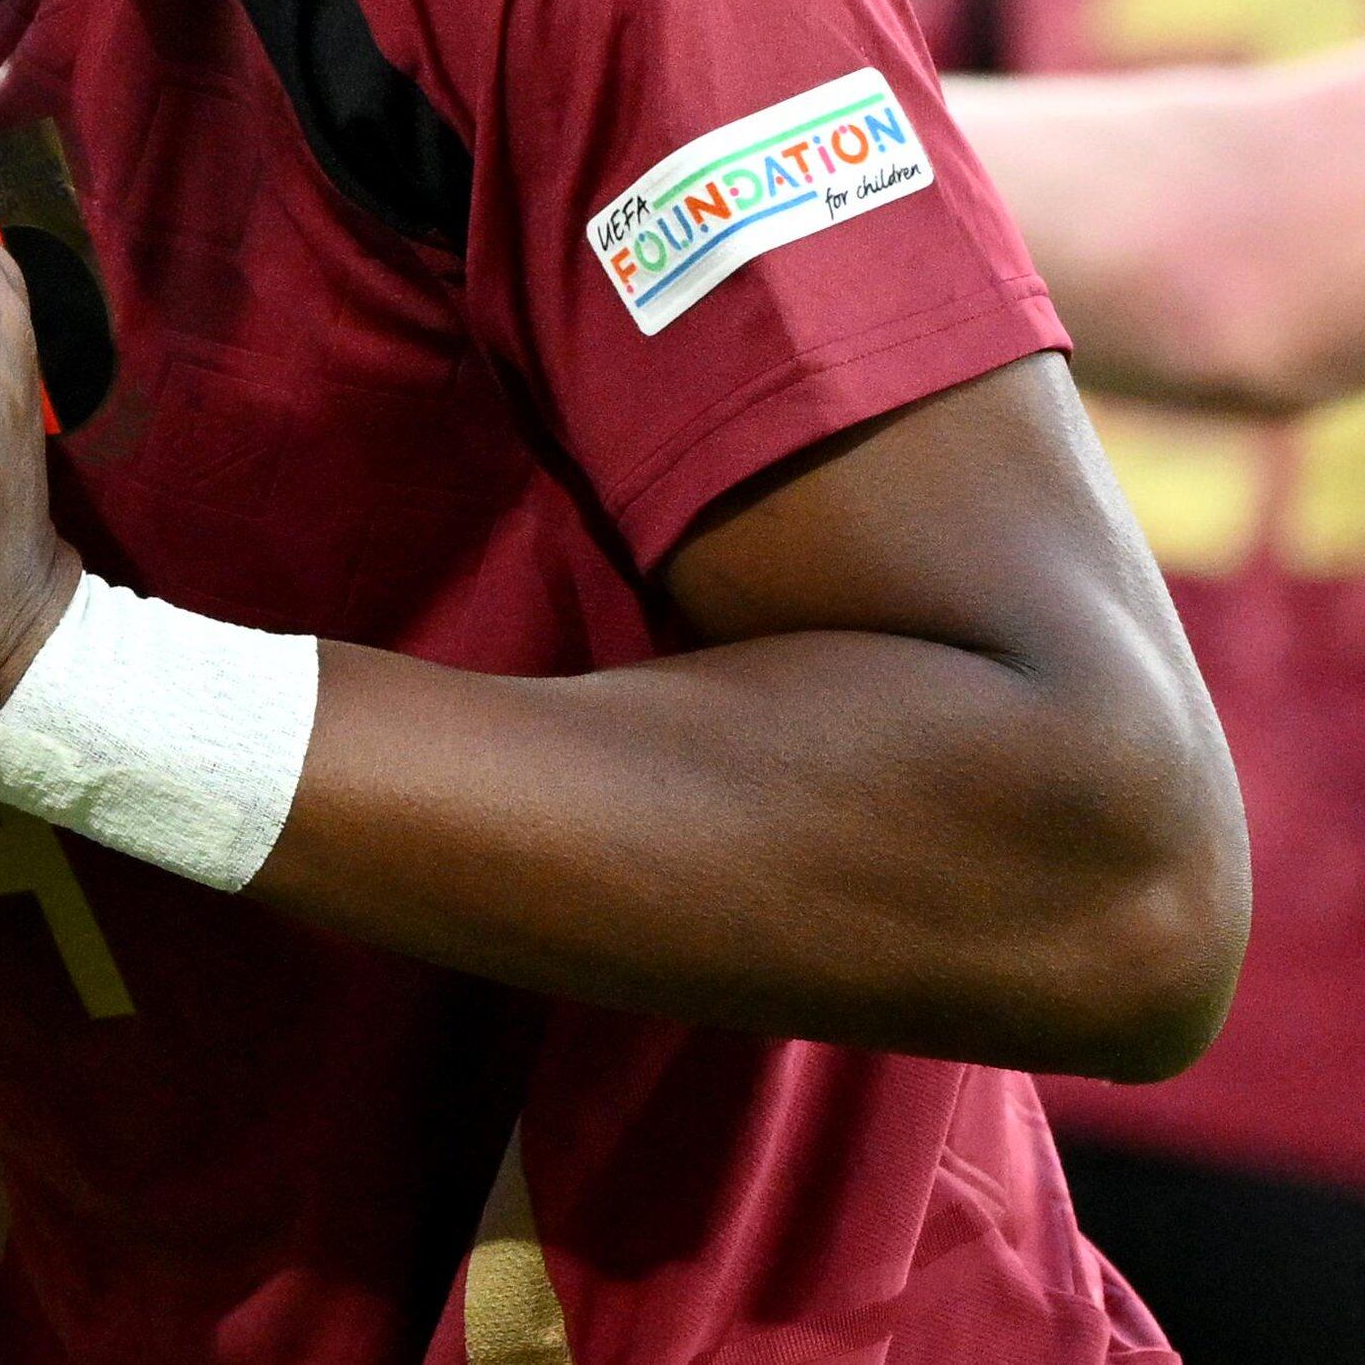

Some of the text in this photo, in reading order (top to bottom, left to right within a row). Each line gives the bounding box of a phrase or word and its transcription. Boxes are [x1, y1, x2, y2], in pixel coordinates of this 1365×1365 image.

[824, 162, 921, 220] for children
[597, 194, 650, 251] UEFA
